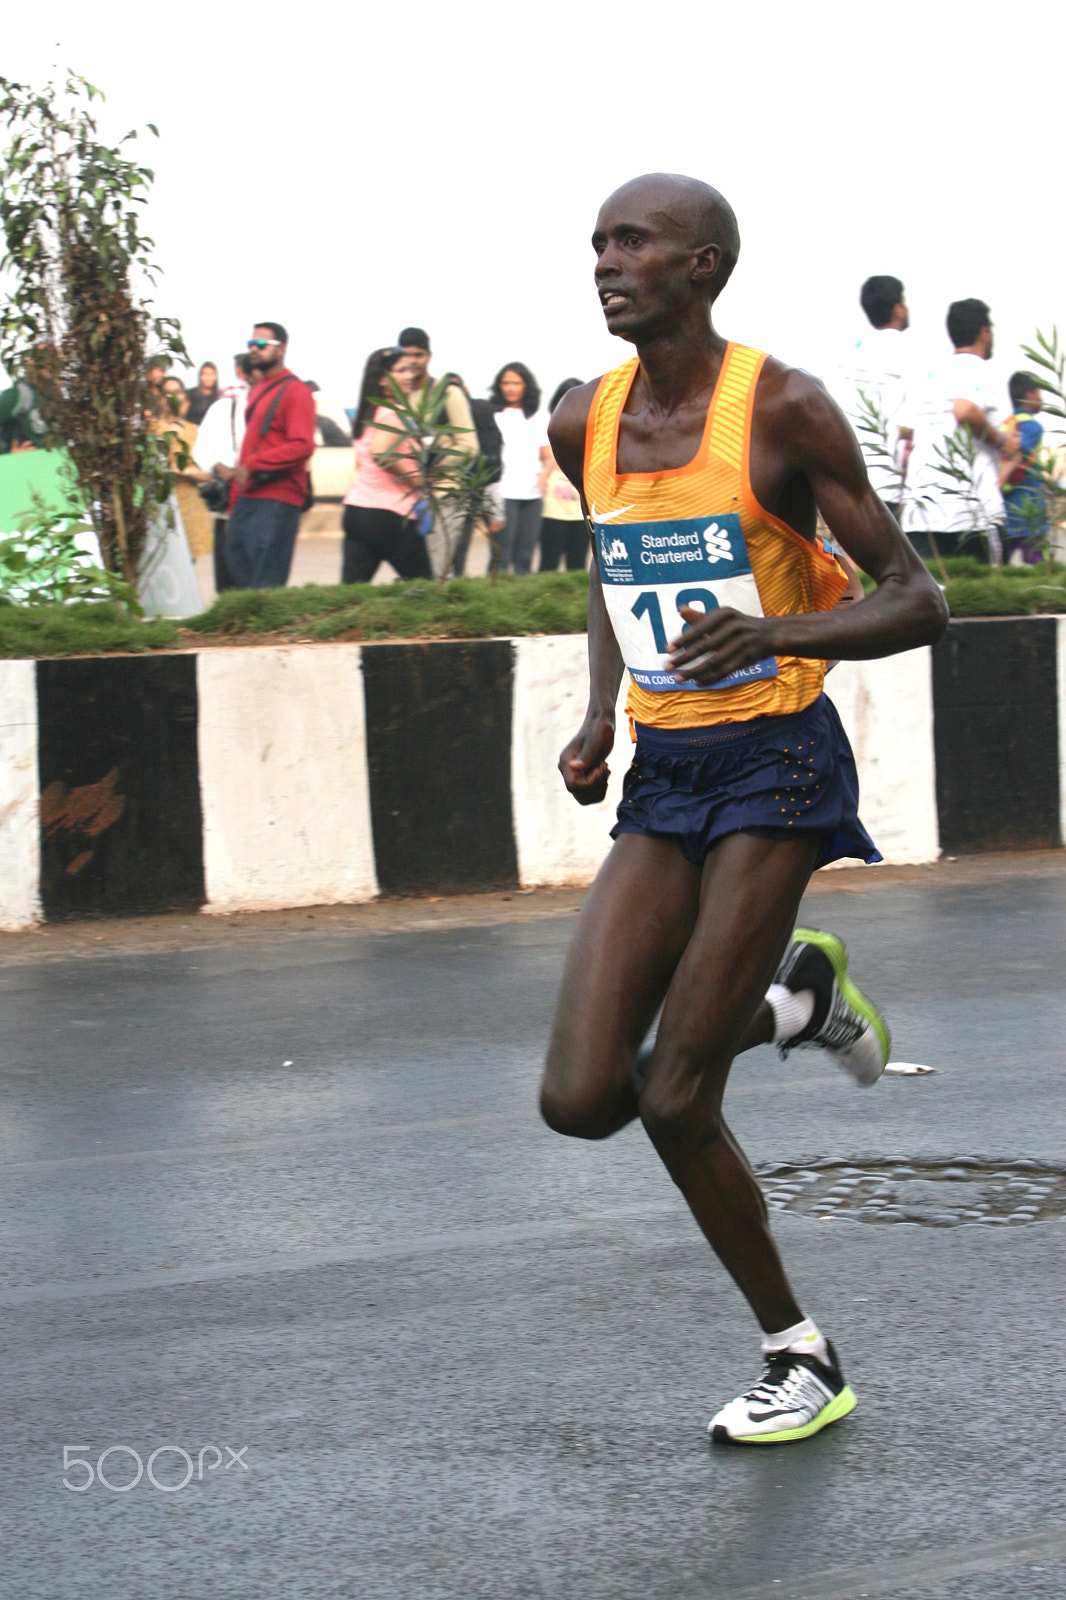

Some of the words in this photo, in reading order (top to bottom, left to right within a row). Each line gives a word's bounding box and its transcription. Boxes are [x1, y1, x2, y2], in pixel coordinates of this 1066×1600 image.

[641, 531, 700, 548] Standard
[640, 548, 703, 565] Chartered
[724, 664, 762, 680] VICES
